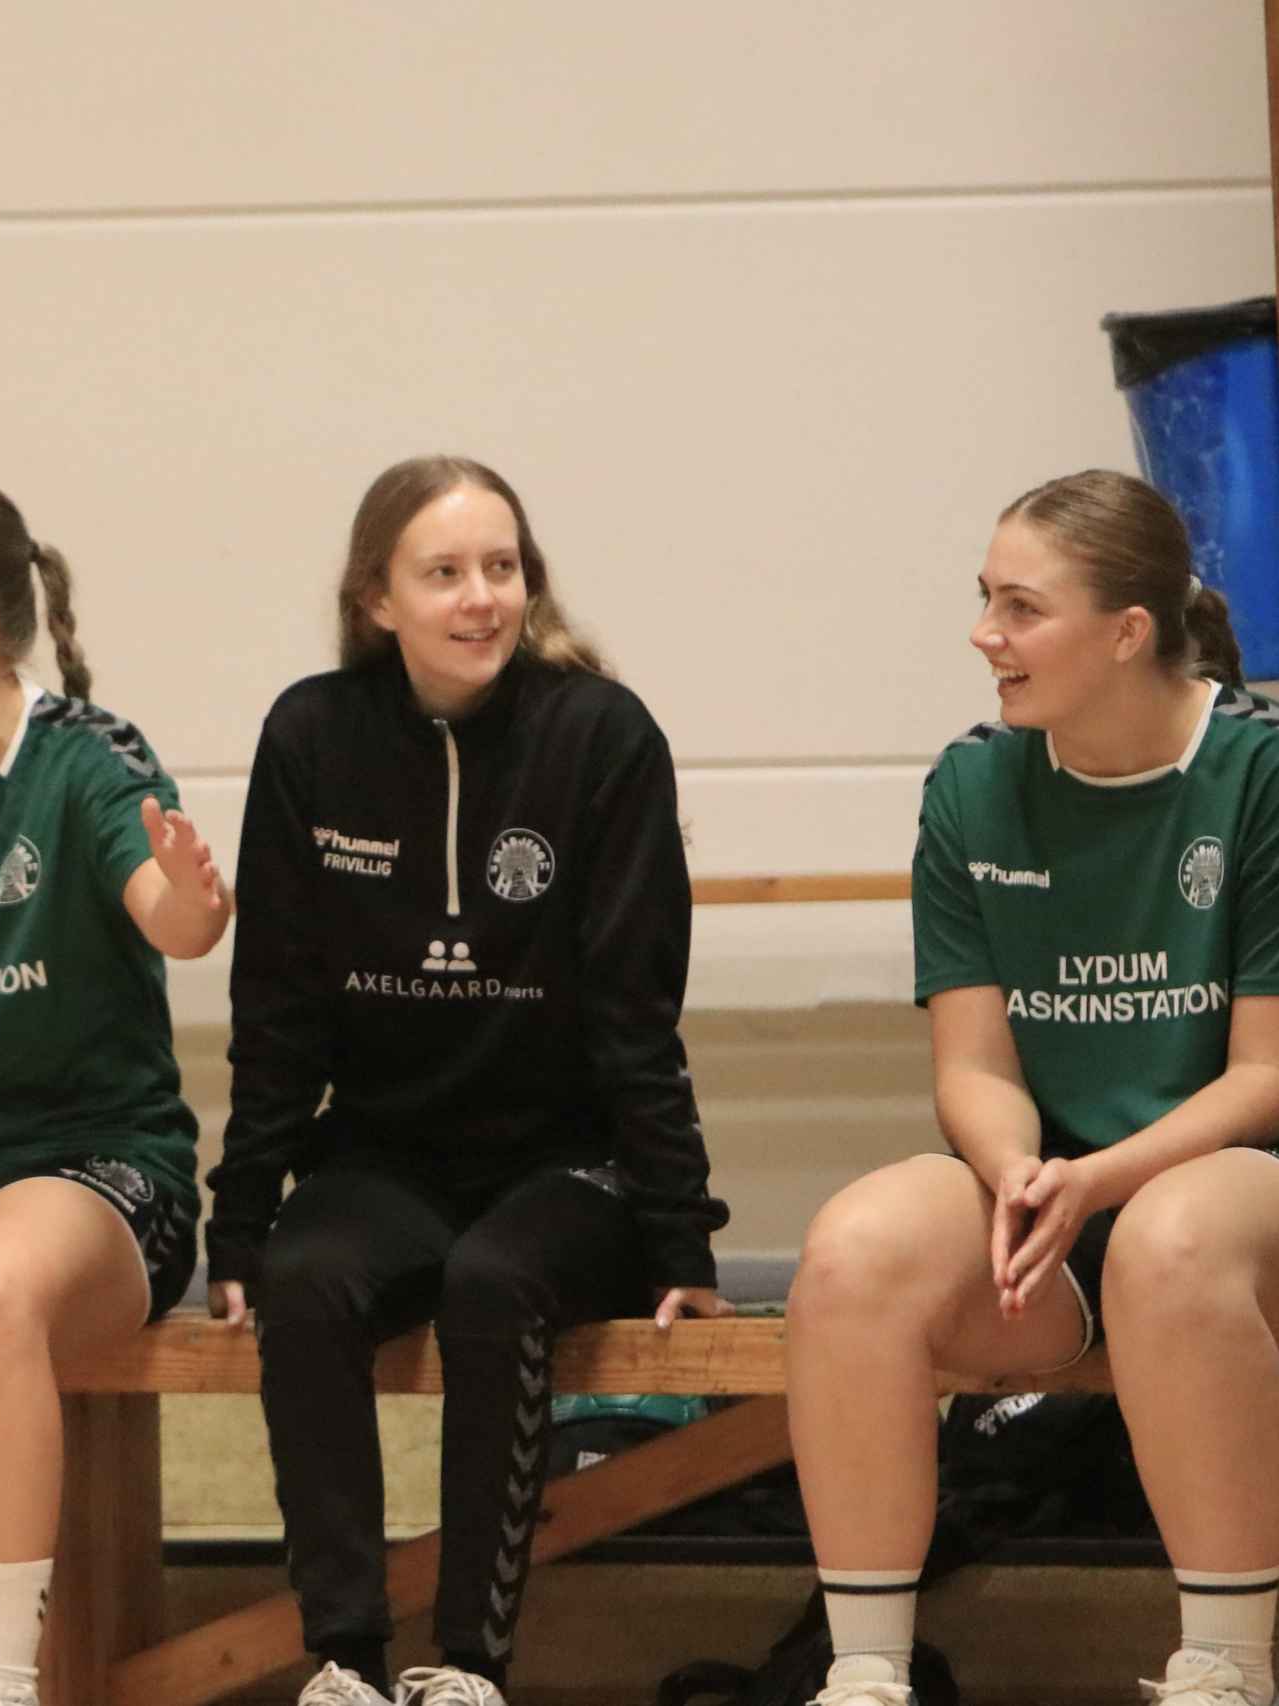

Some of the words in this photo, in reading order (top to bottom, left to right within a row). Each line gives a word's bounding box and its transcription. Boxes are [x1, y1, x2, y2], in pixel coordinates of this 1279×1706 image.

[323, 852, 392, 877] FRIVILLIG
[1058, 950, 1169, 986] LYDUM
[344, 971, 502, 998] AXELGAARD
[1006, 980, 1229, 1023] ASKINSTATION
